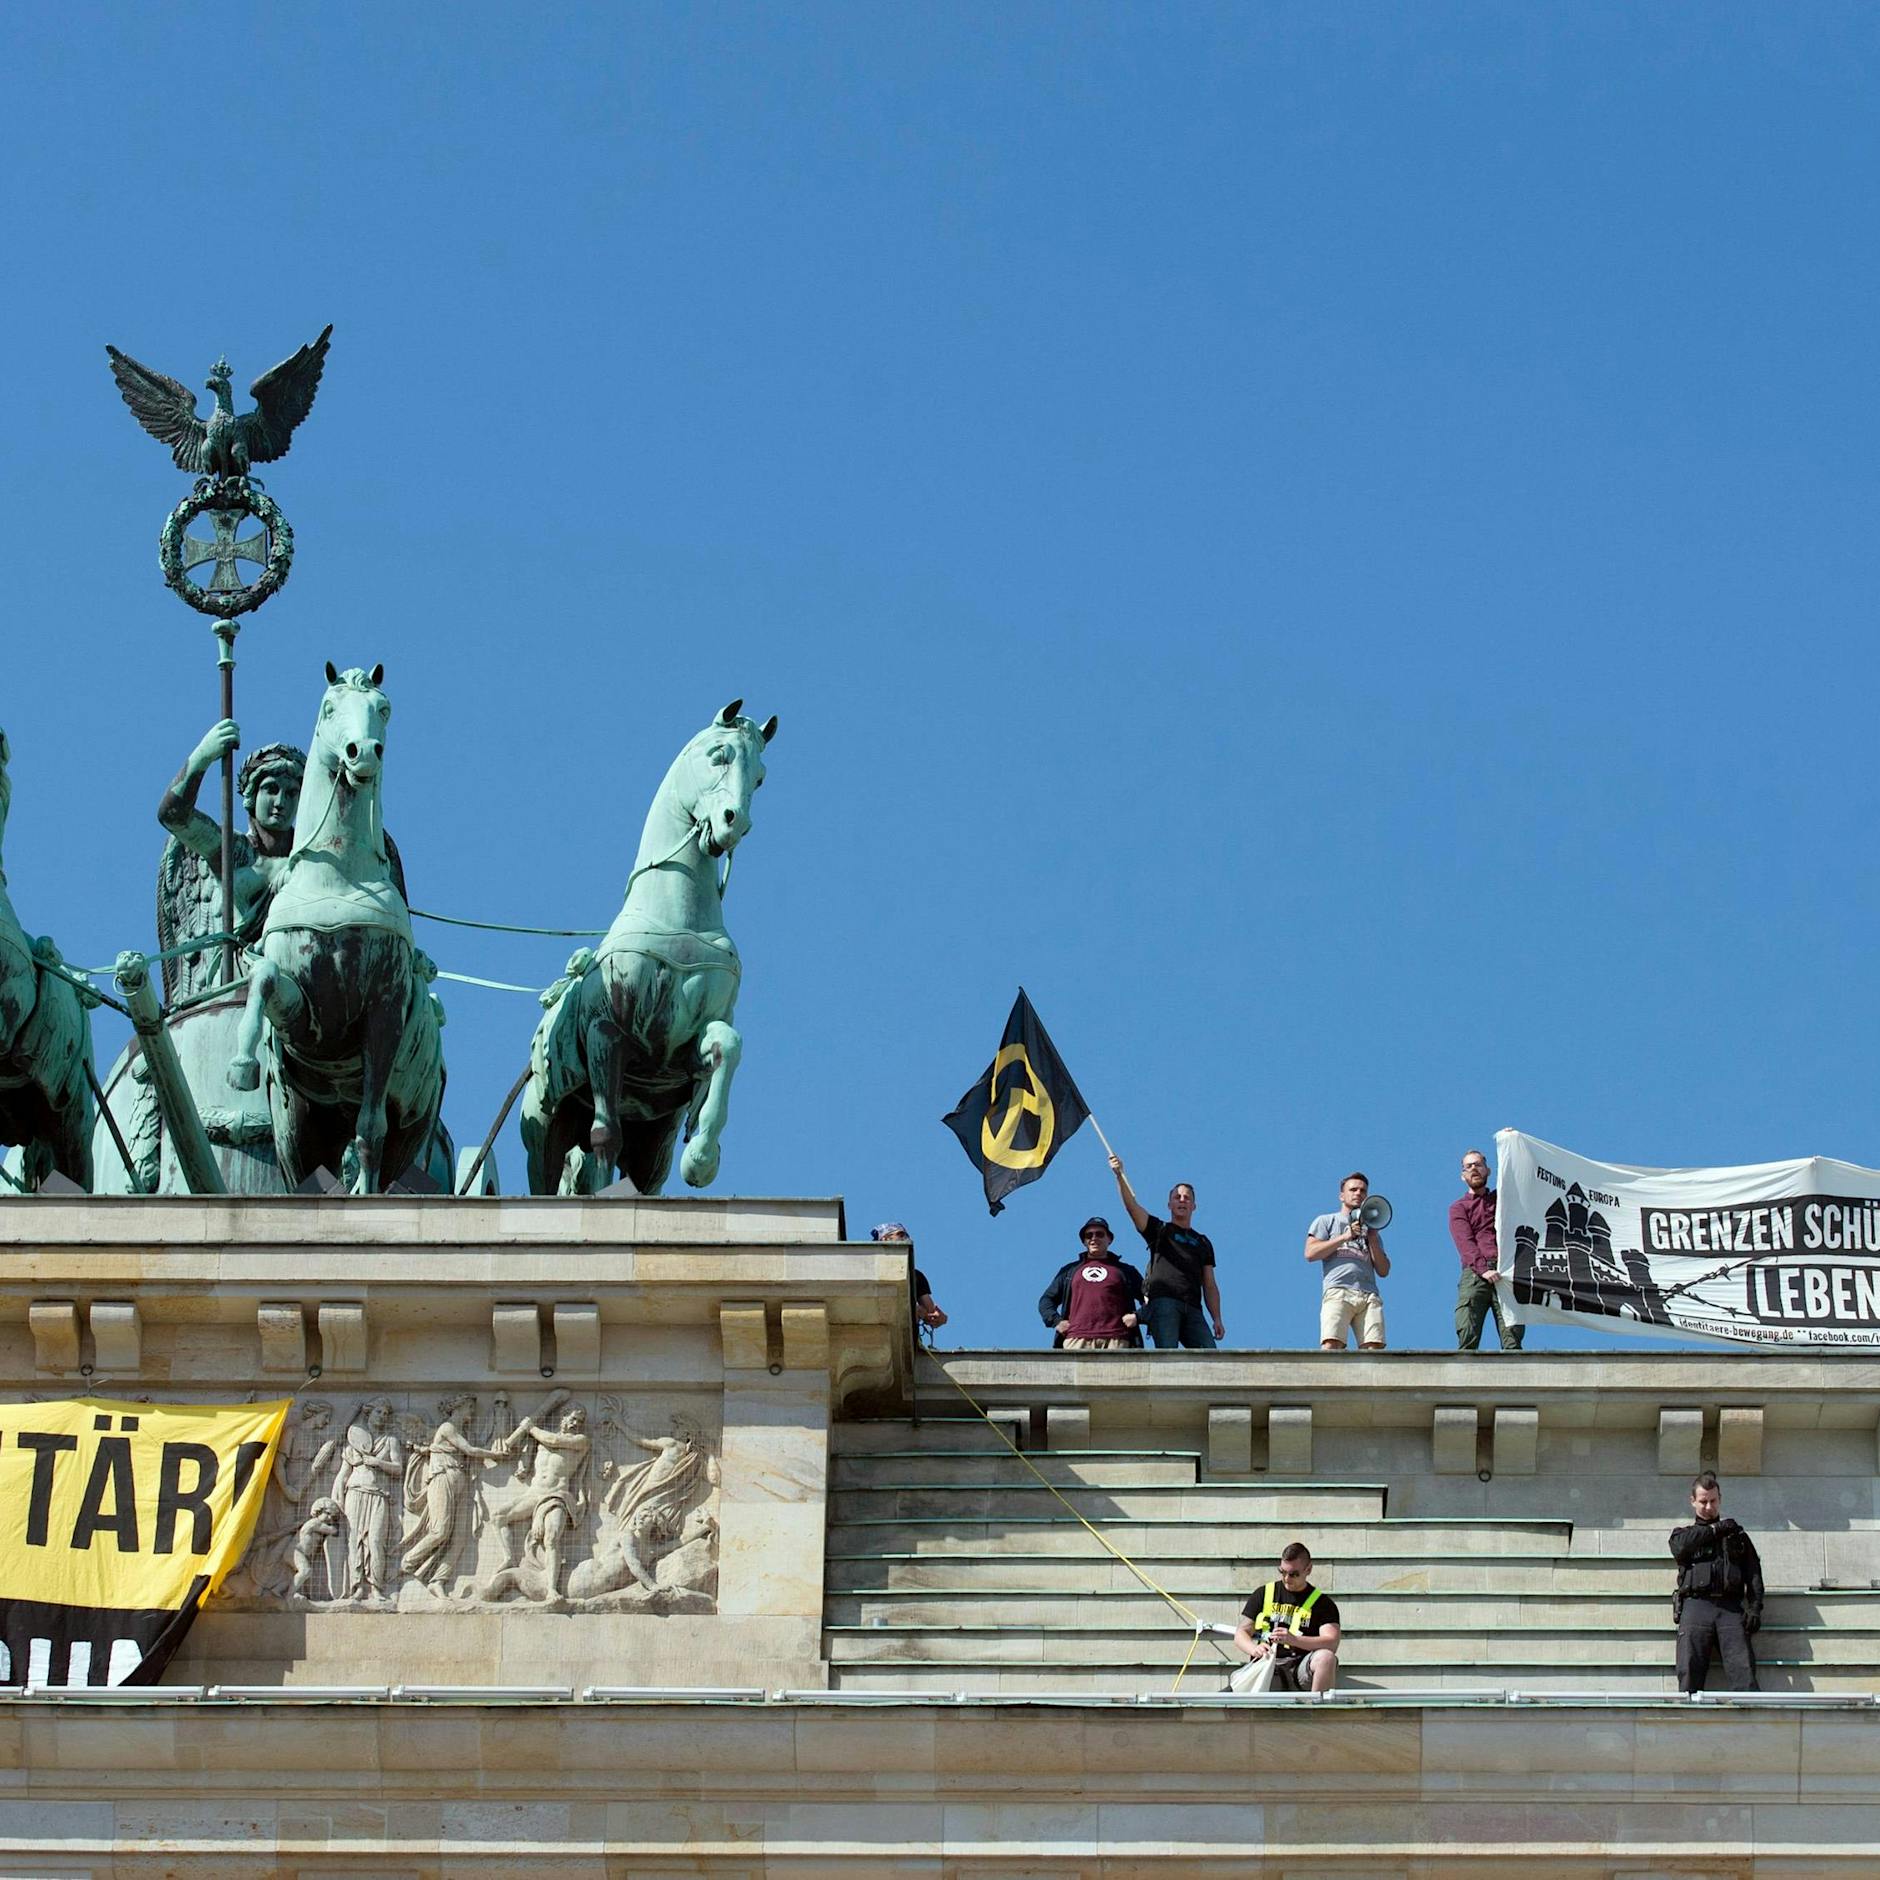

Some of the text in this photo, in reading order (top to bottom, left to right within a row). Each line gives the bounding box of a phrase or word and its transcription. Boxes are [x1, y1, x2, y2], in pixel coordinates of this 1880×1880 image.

[1537, 1166, 1566, 1190] FESTUNG
[1589, 1190, 1620, 1208] EUROPA
[1649, 1200, 1880, 1252] GRENZEN SCHÜ
[1754, 1267, 1880, 1320] LEBEN
[1679, 1318, 1880, 1344] identitaere-bewegung.de facebook.com/i
[0, 1414, 268, 1556] TÄR
